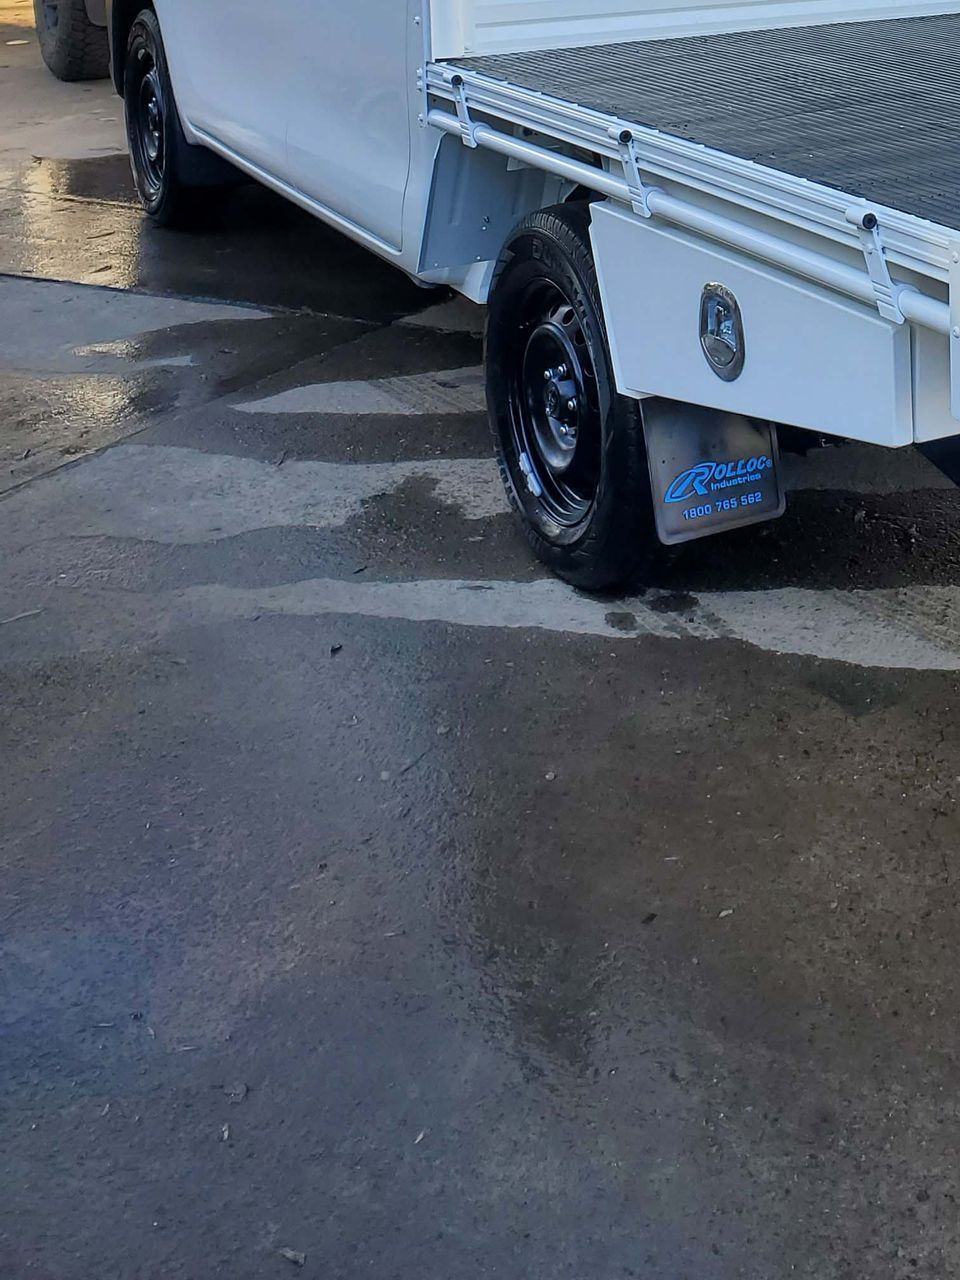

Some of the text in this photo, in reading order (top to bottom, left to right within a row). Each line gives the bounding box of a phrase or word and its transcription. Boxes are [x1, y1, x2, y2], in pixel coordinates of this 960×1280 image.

[711, 473, 762, 491] Industries
[683, 492, 762, 520] 1800 765 562
